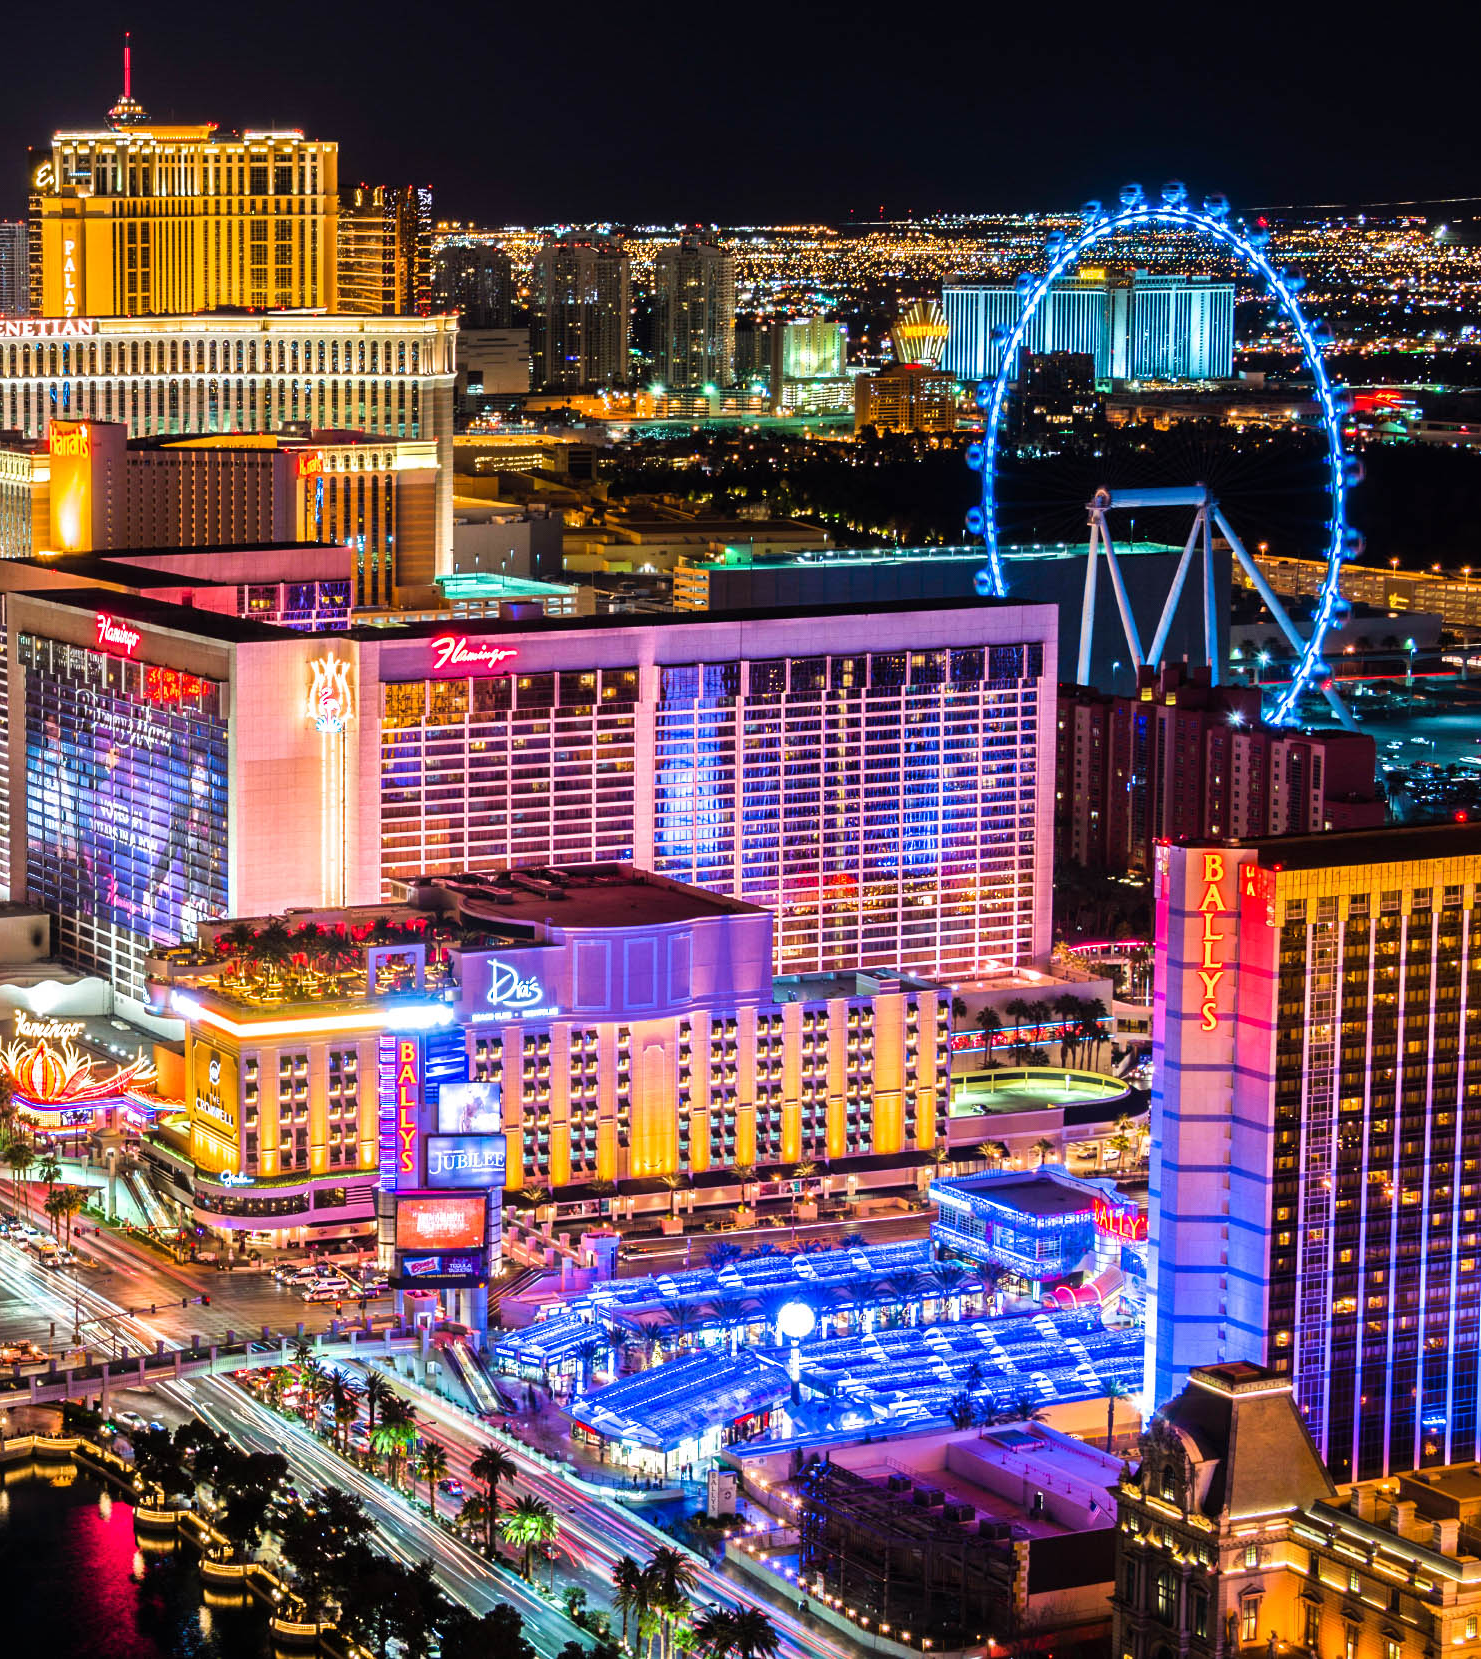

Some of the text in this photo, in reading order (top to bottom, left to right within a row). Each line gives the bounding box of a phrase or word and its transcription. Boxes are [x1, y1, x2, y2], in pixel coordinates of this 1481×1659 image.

[904, 324, 949, 337] WESTGATE
[97, 614, 141, 654] Flamingo
[431, 637, 518, 669] Flamingo
[1197, 854, 1227, 1032] BALLYS
[486, 958, 543, 1007] Drai's
[14, 1008, 86, 1050] Flamingo
[195, 1096, 234, 1128] CROMWELL
[209, 1092, 221, 1105] THE
[398, 1041, 417, 1173] BALLYS
[428, 1151, 505, 1175] JUBILEE
